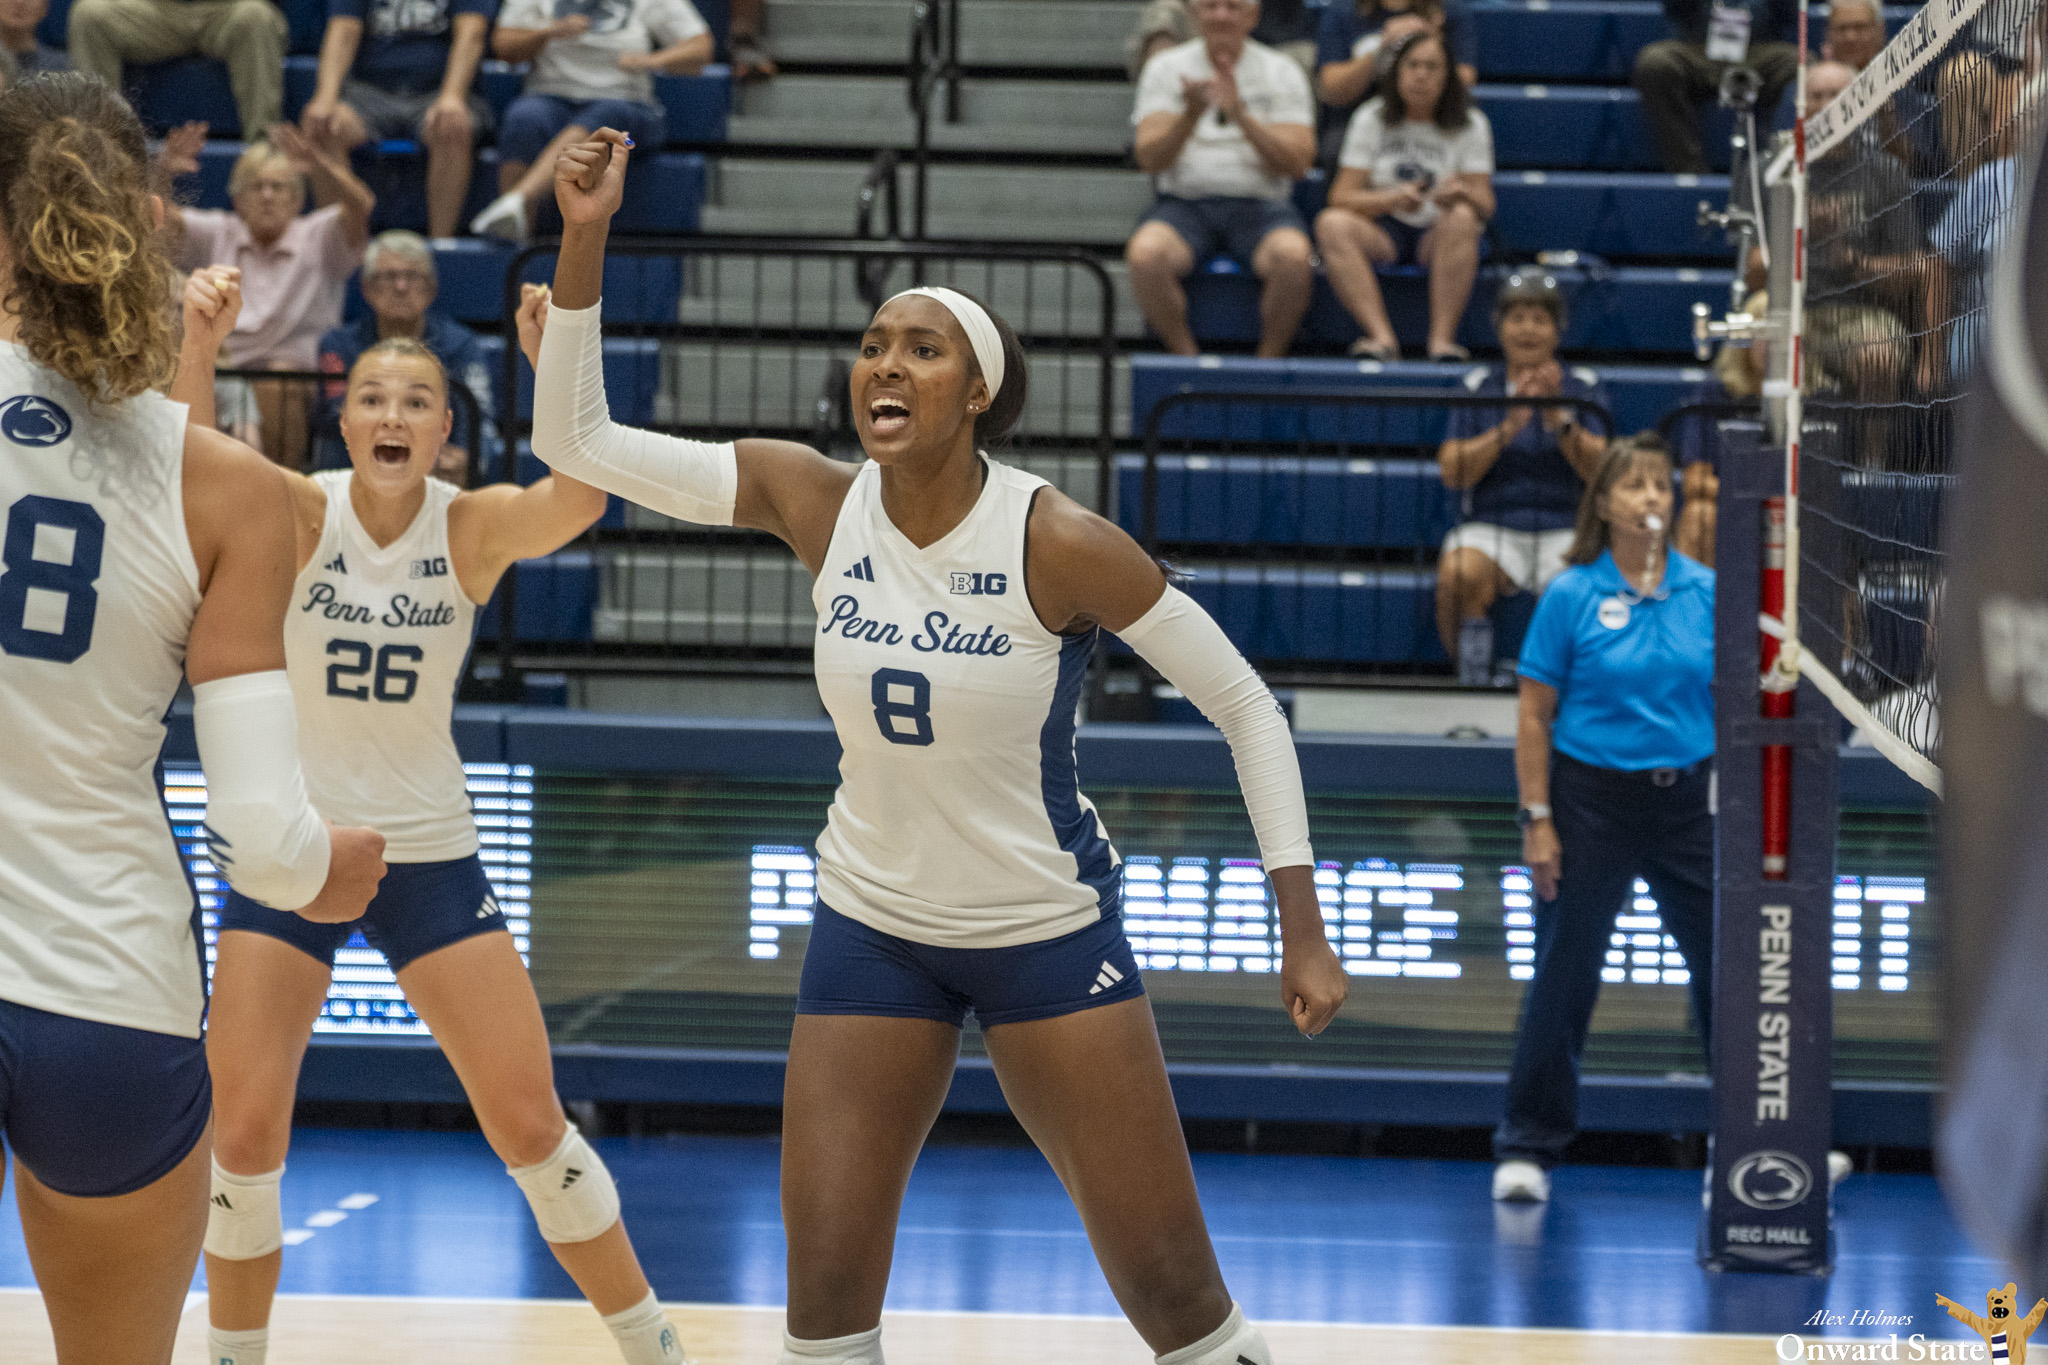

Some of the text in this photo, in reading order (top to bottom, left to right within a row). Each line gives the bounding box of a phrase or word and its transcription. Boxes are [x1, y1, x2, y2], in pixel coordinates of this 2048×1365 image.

[0, 494, 106, 664] 8
[302, 582, 455, 627] Penn State
[822, 594, 1012, 656] Penn State
[326, 638, 424, 704] 26
[871, 667, 935, 746] 8
[1757, 905, 1792, 1121] PENN STATE
[1726, 1226, 1811, 1244] REC HALL
